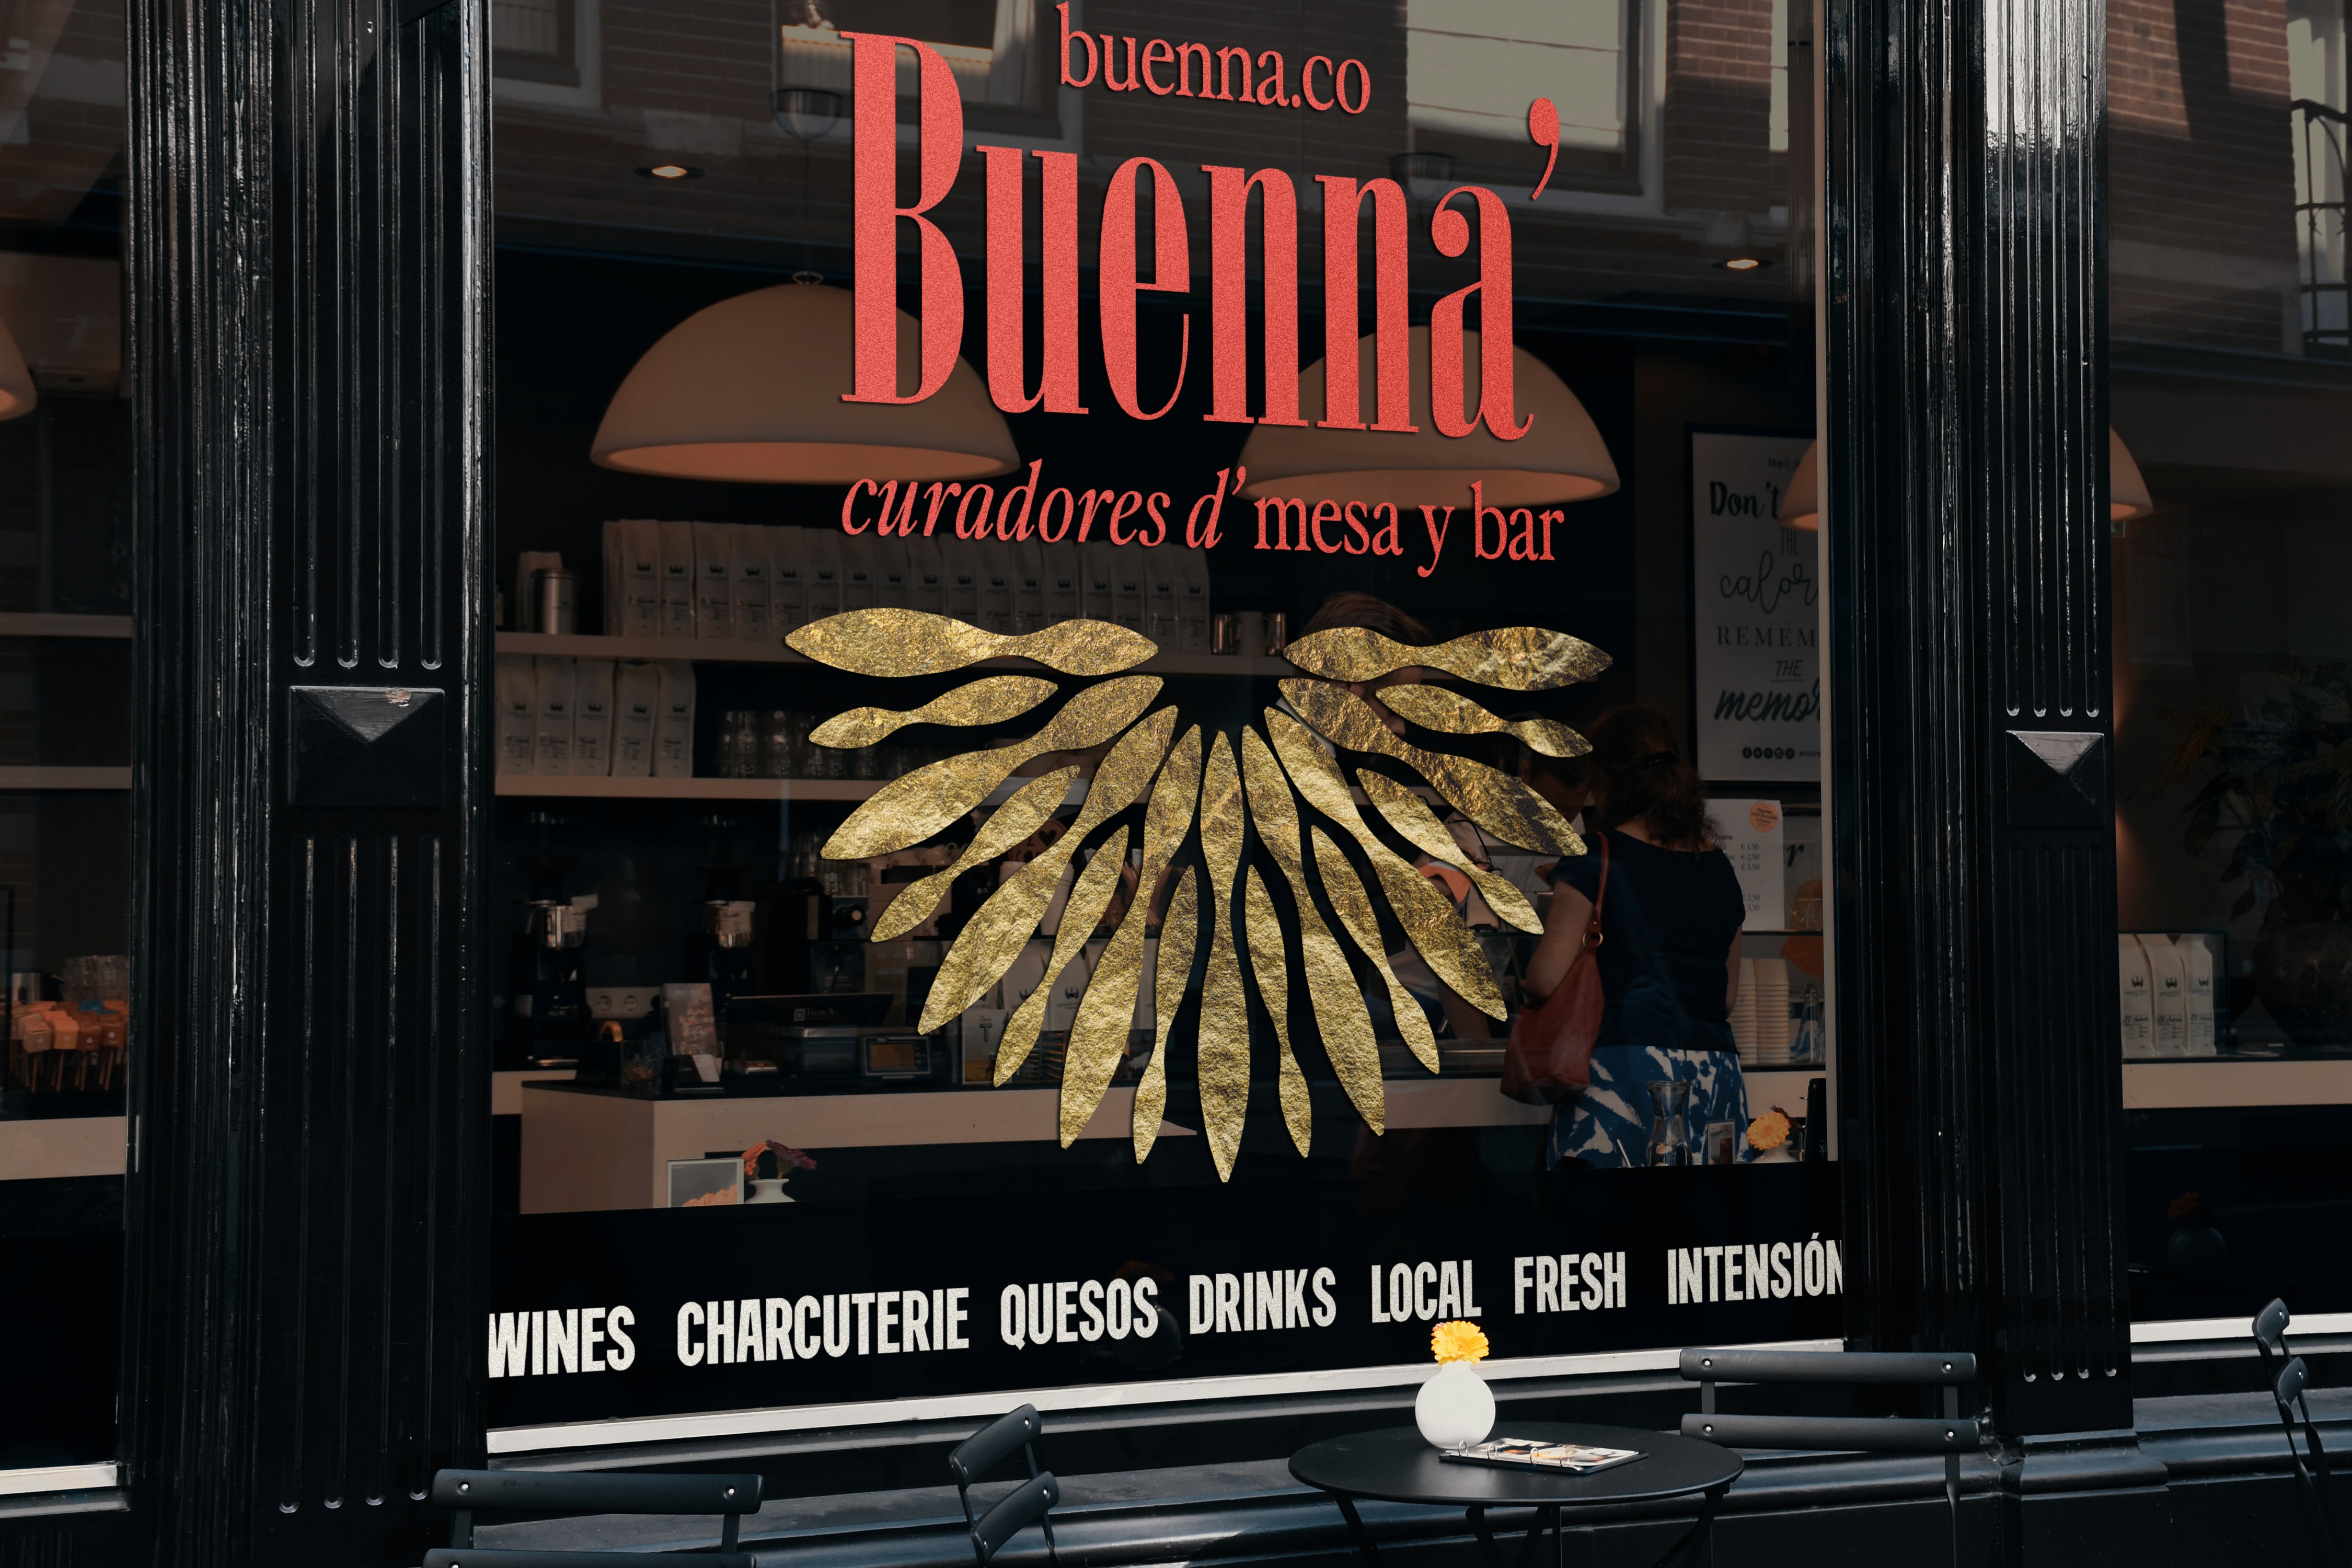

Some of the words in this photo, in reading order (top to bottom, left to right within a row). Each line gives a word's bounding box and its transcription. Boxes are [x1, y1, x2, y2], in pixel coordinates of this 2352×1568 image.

[1057, 2, 1370, 114] buenna.co
[840, 31, 1560, 440] Buenna'
[841, 458, 1170, 547] curadores
[1186, 466, 1246, 549] d'
[1254, 496, 1403, 556] mesa
[1417, 504, 1455, 578] y
[1470, 480, 1564, 561] bar
[1710, 481, 1780, 518] Don't
[1717, 627, 1815, 647] REMEM
[1775, 660, 1803, 676] THE
[488, 1306, 635, 1378] WINES
[677, 1288, 969, 1366] CHARCUTERIE
[1001, 1277, 1161, 1350] QUESOS
[1189, 1267, 1336, 1334] DRINKS
[1372, 1260, 1482, 1323] LOCAL
[1515, 1252, 1626, 1314] FRESH
[1668, 1232, 1843, 1305] INTENSIÓN
